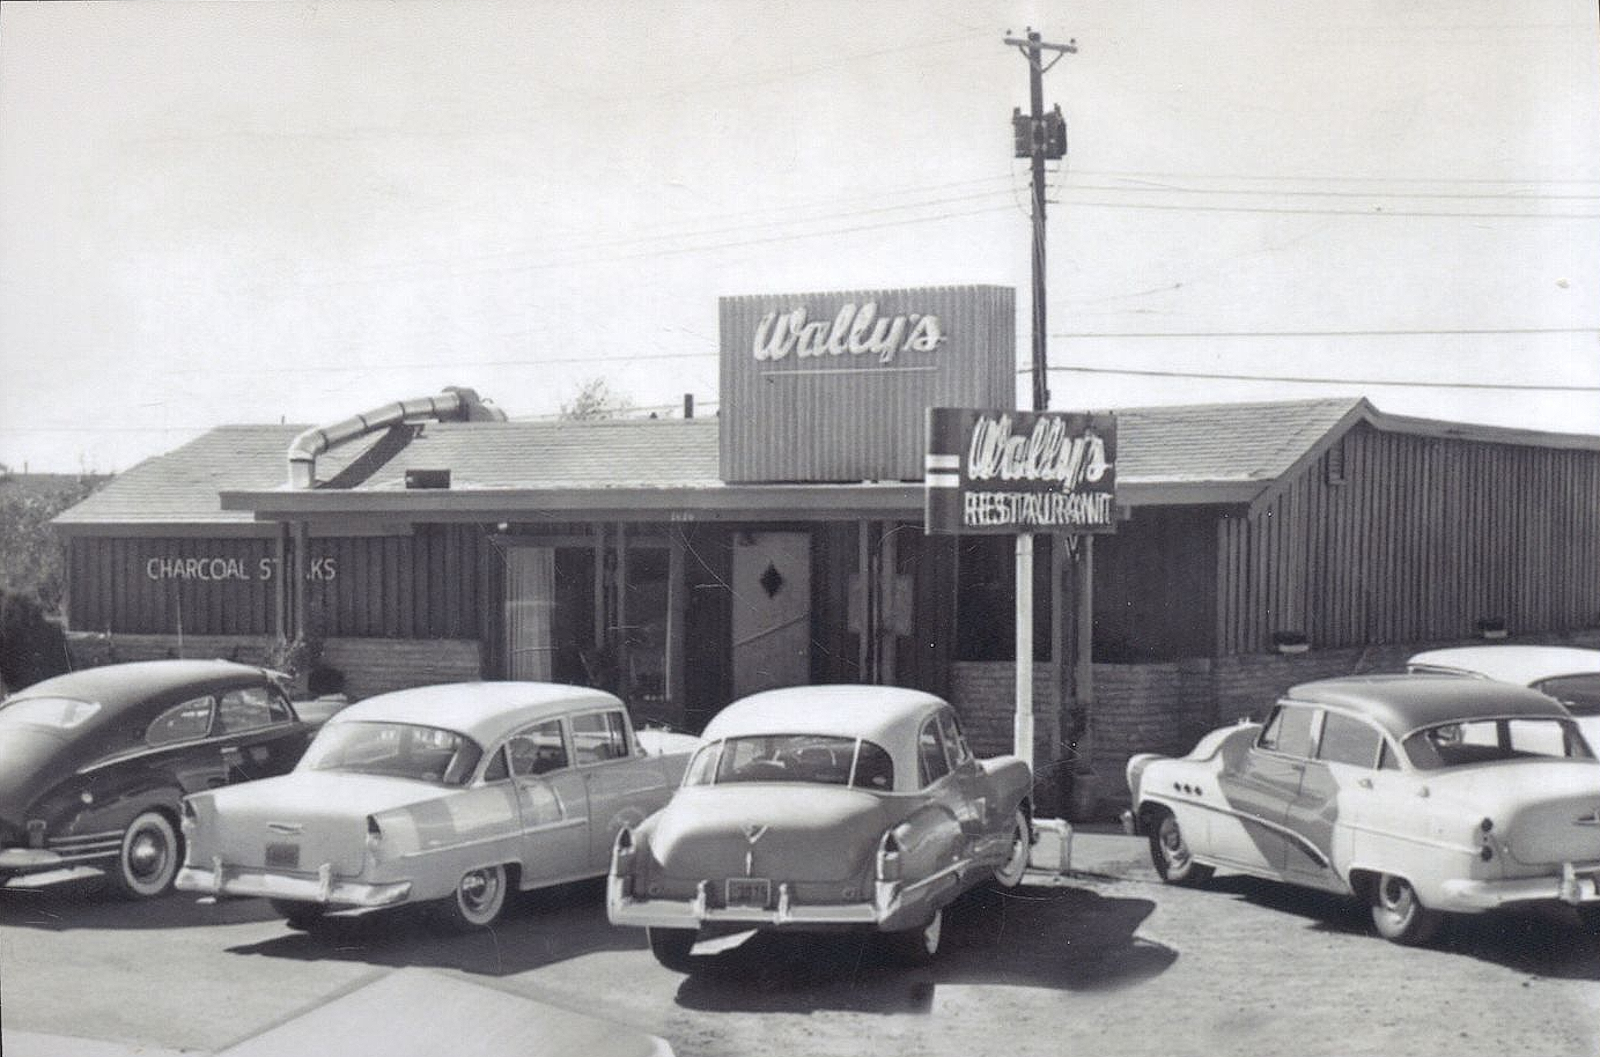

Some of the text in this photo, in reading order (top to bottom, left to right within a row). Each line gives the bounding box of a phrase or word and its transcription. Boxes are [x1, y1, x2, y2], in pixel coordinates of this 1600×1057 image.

[753, 302, 947, 363] Wally's
[968, 414, 1113, 494] Wally's
[964, 491, 1114, 525] RESTAURANT
[147, 558, 336, 581] CHARCOAL SKS
